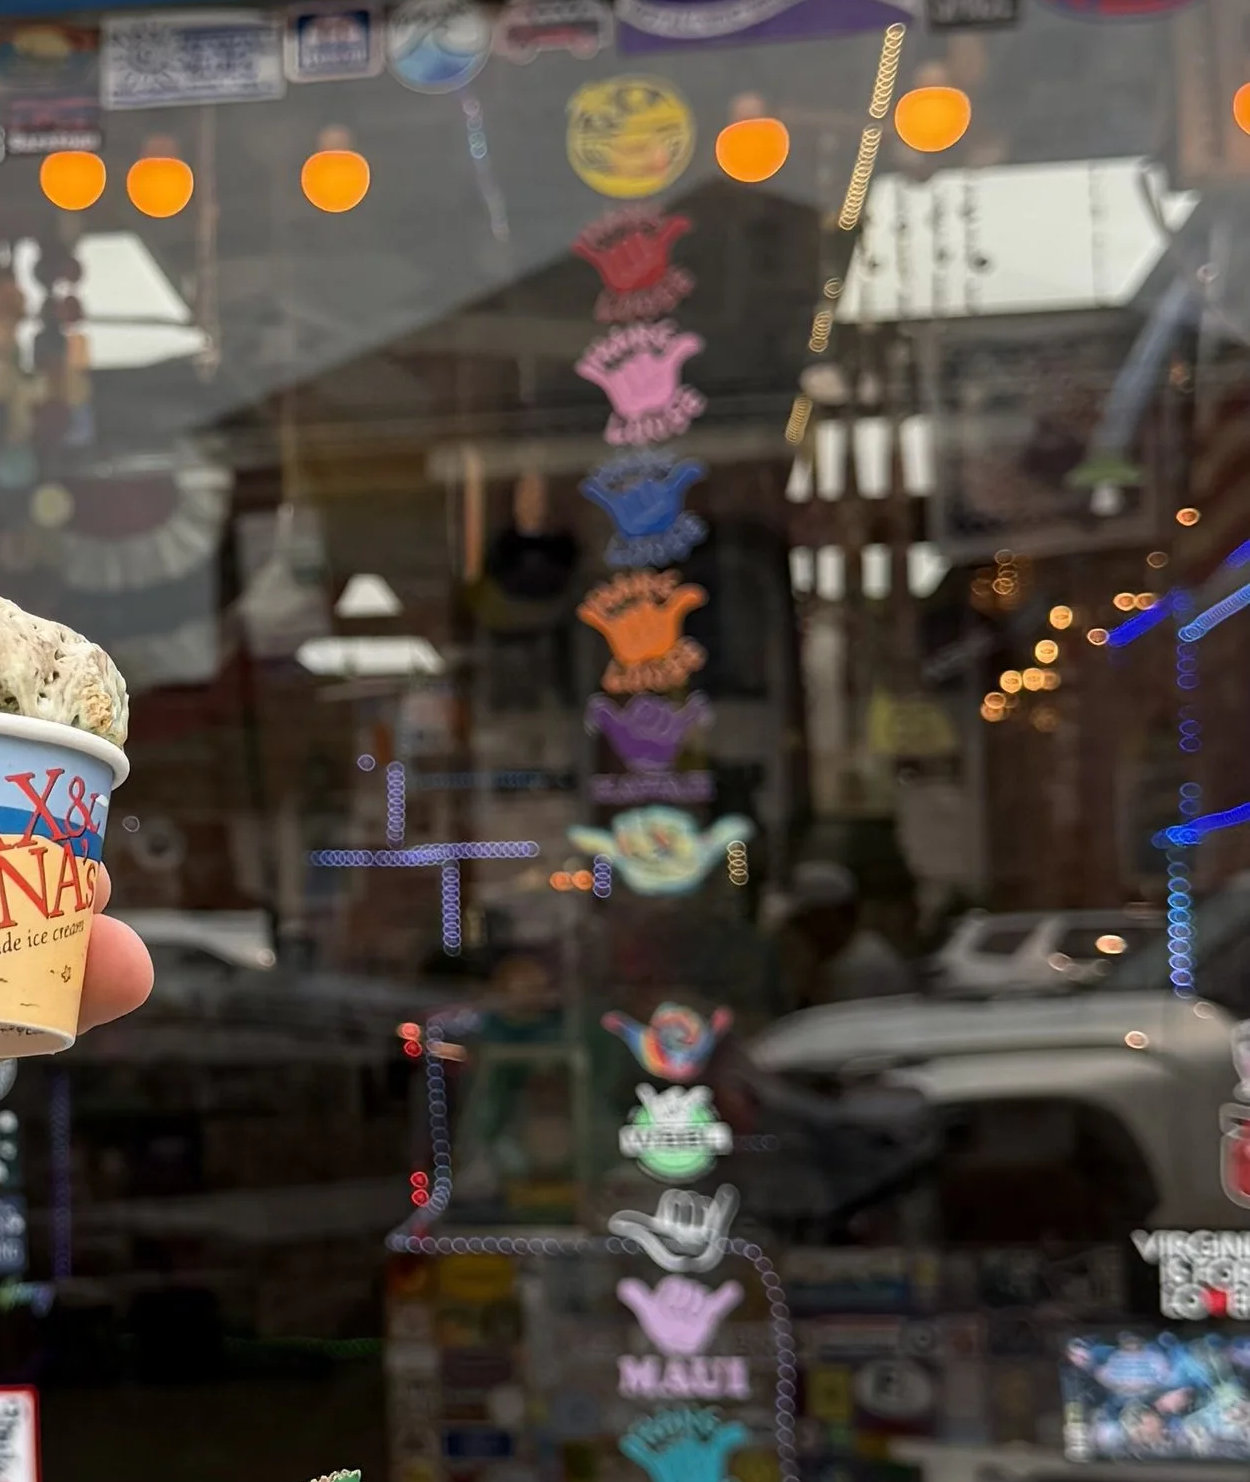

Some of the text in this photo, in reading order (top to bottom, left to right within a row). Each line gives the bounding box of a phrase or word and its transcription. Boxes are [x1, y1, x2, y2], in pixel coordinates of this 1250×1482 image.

[28, 929, 48, 948] ice
[52, 920, 85, 942] cream
[617, 1355, 750, 1398] MAUI
